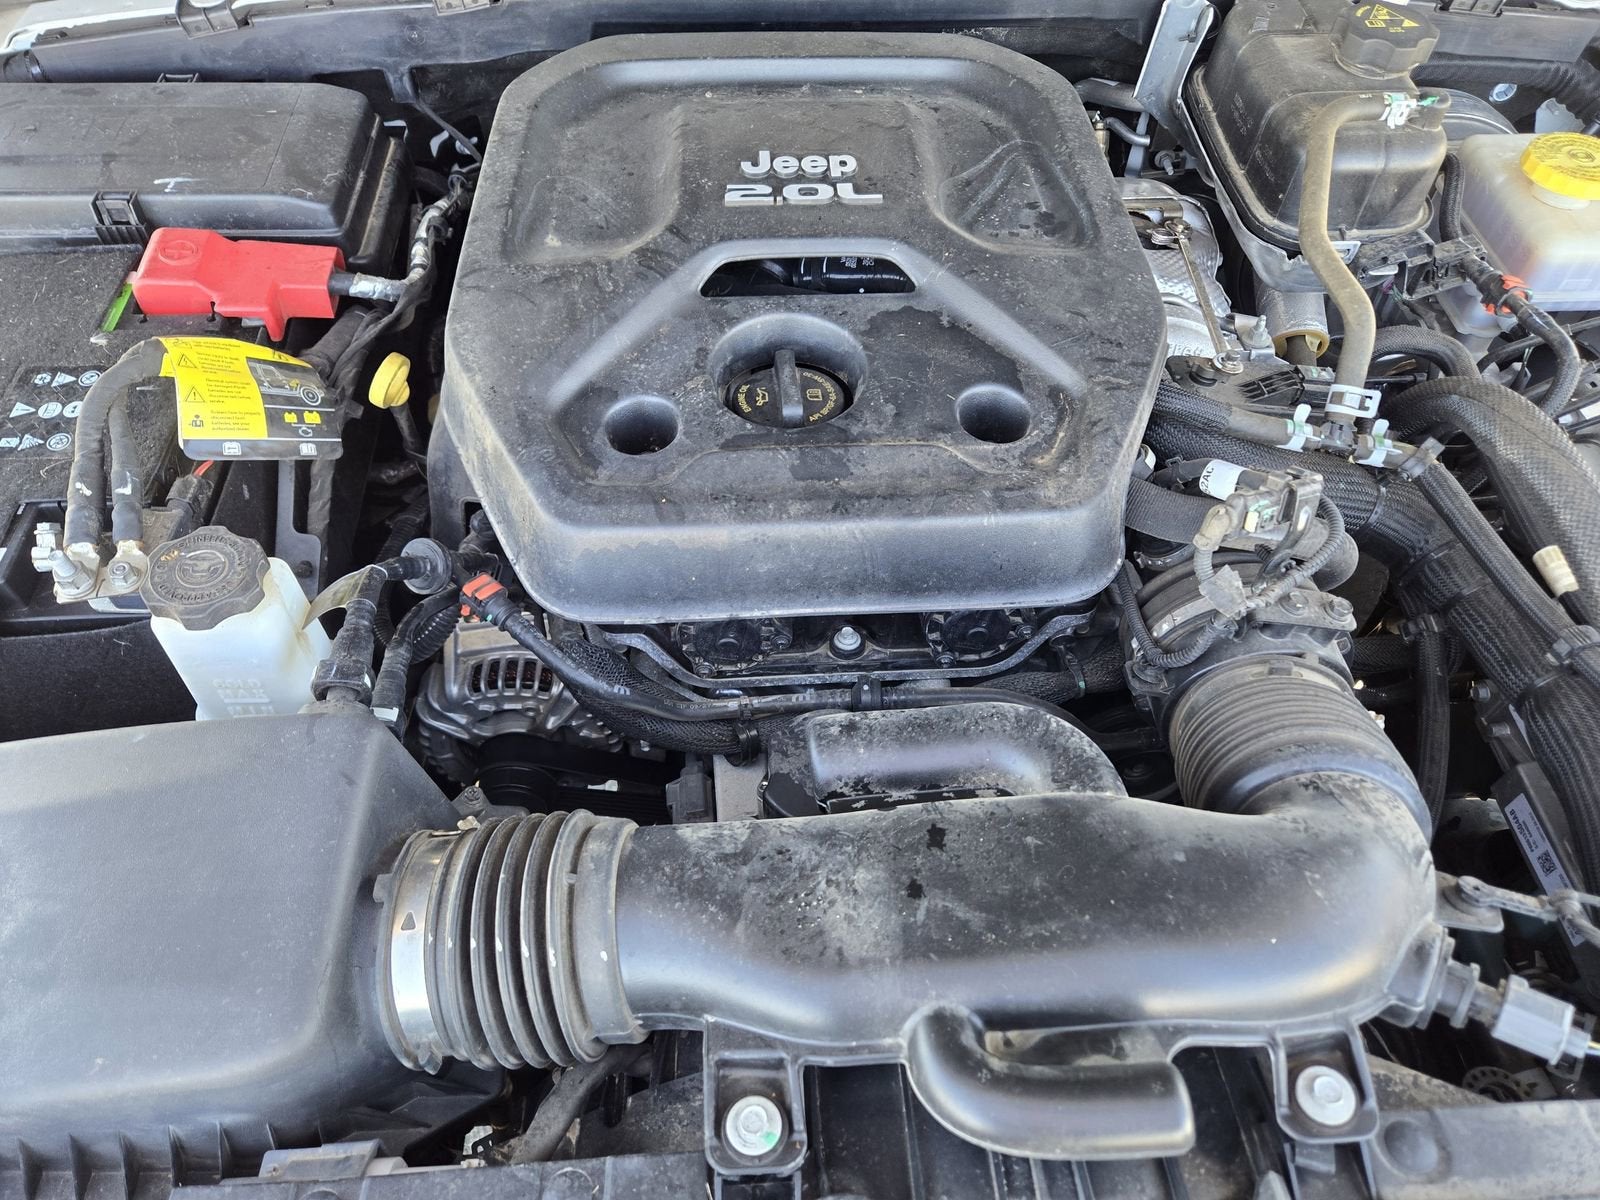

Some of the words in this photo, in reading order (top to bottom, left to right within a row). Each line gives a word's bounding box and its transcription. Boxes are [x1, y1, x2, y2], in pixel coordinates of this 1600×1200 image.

[740, 149, 859, 183] Jeep
[724, 182, 884, 207] 2.0L
[739, 384, 751, 393] OIL
[737, 393, 752, 413] ENGINE
[809, 412, 823, 422] API
